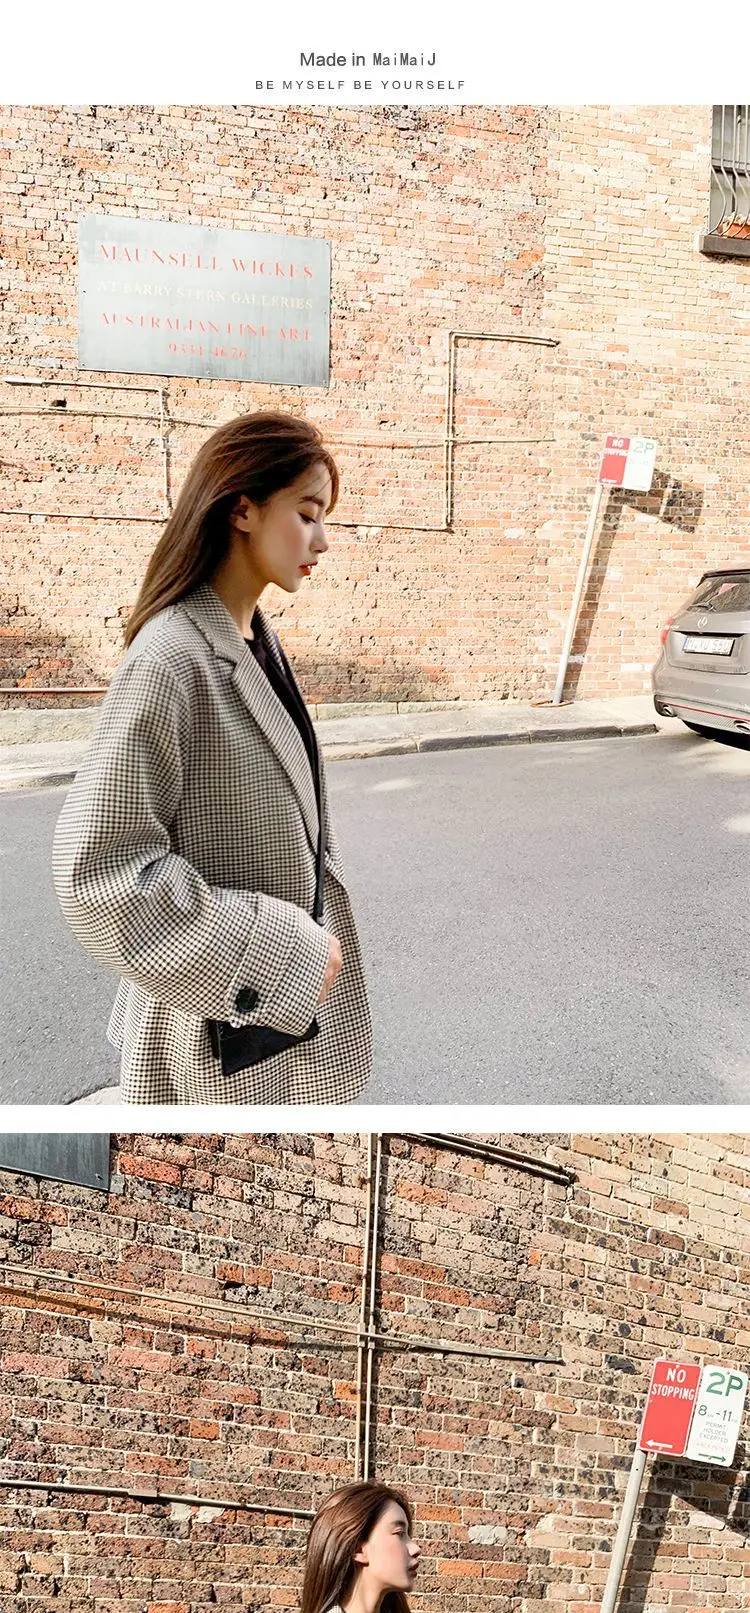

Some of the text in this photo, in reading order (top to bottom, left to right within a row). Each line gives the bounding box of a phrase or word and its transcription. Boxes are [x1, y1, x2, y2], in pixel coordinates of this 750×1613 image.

[231, 258, 314, 280] WICKES
[98, 280, 119, 293] AT
[124, 282, 172, 298] BARRY
[231, 291, 314, 310] GALLERIES
[278, 327, 314, 341] ART
[633, 440, 655, 455] 2P
[666, 1368, 686, 1383] NO
[705, 1371, 744, 1397] 2P
[651, 1383, 696, 1401] STOPPING
